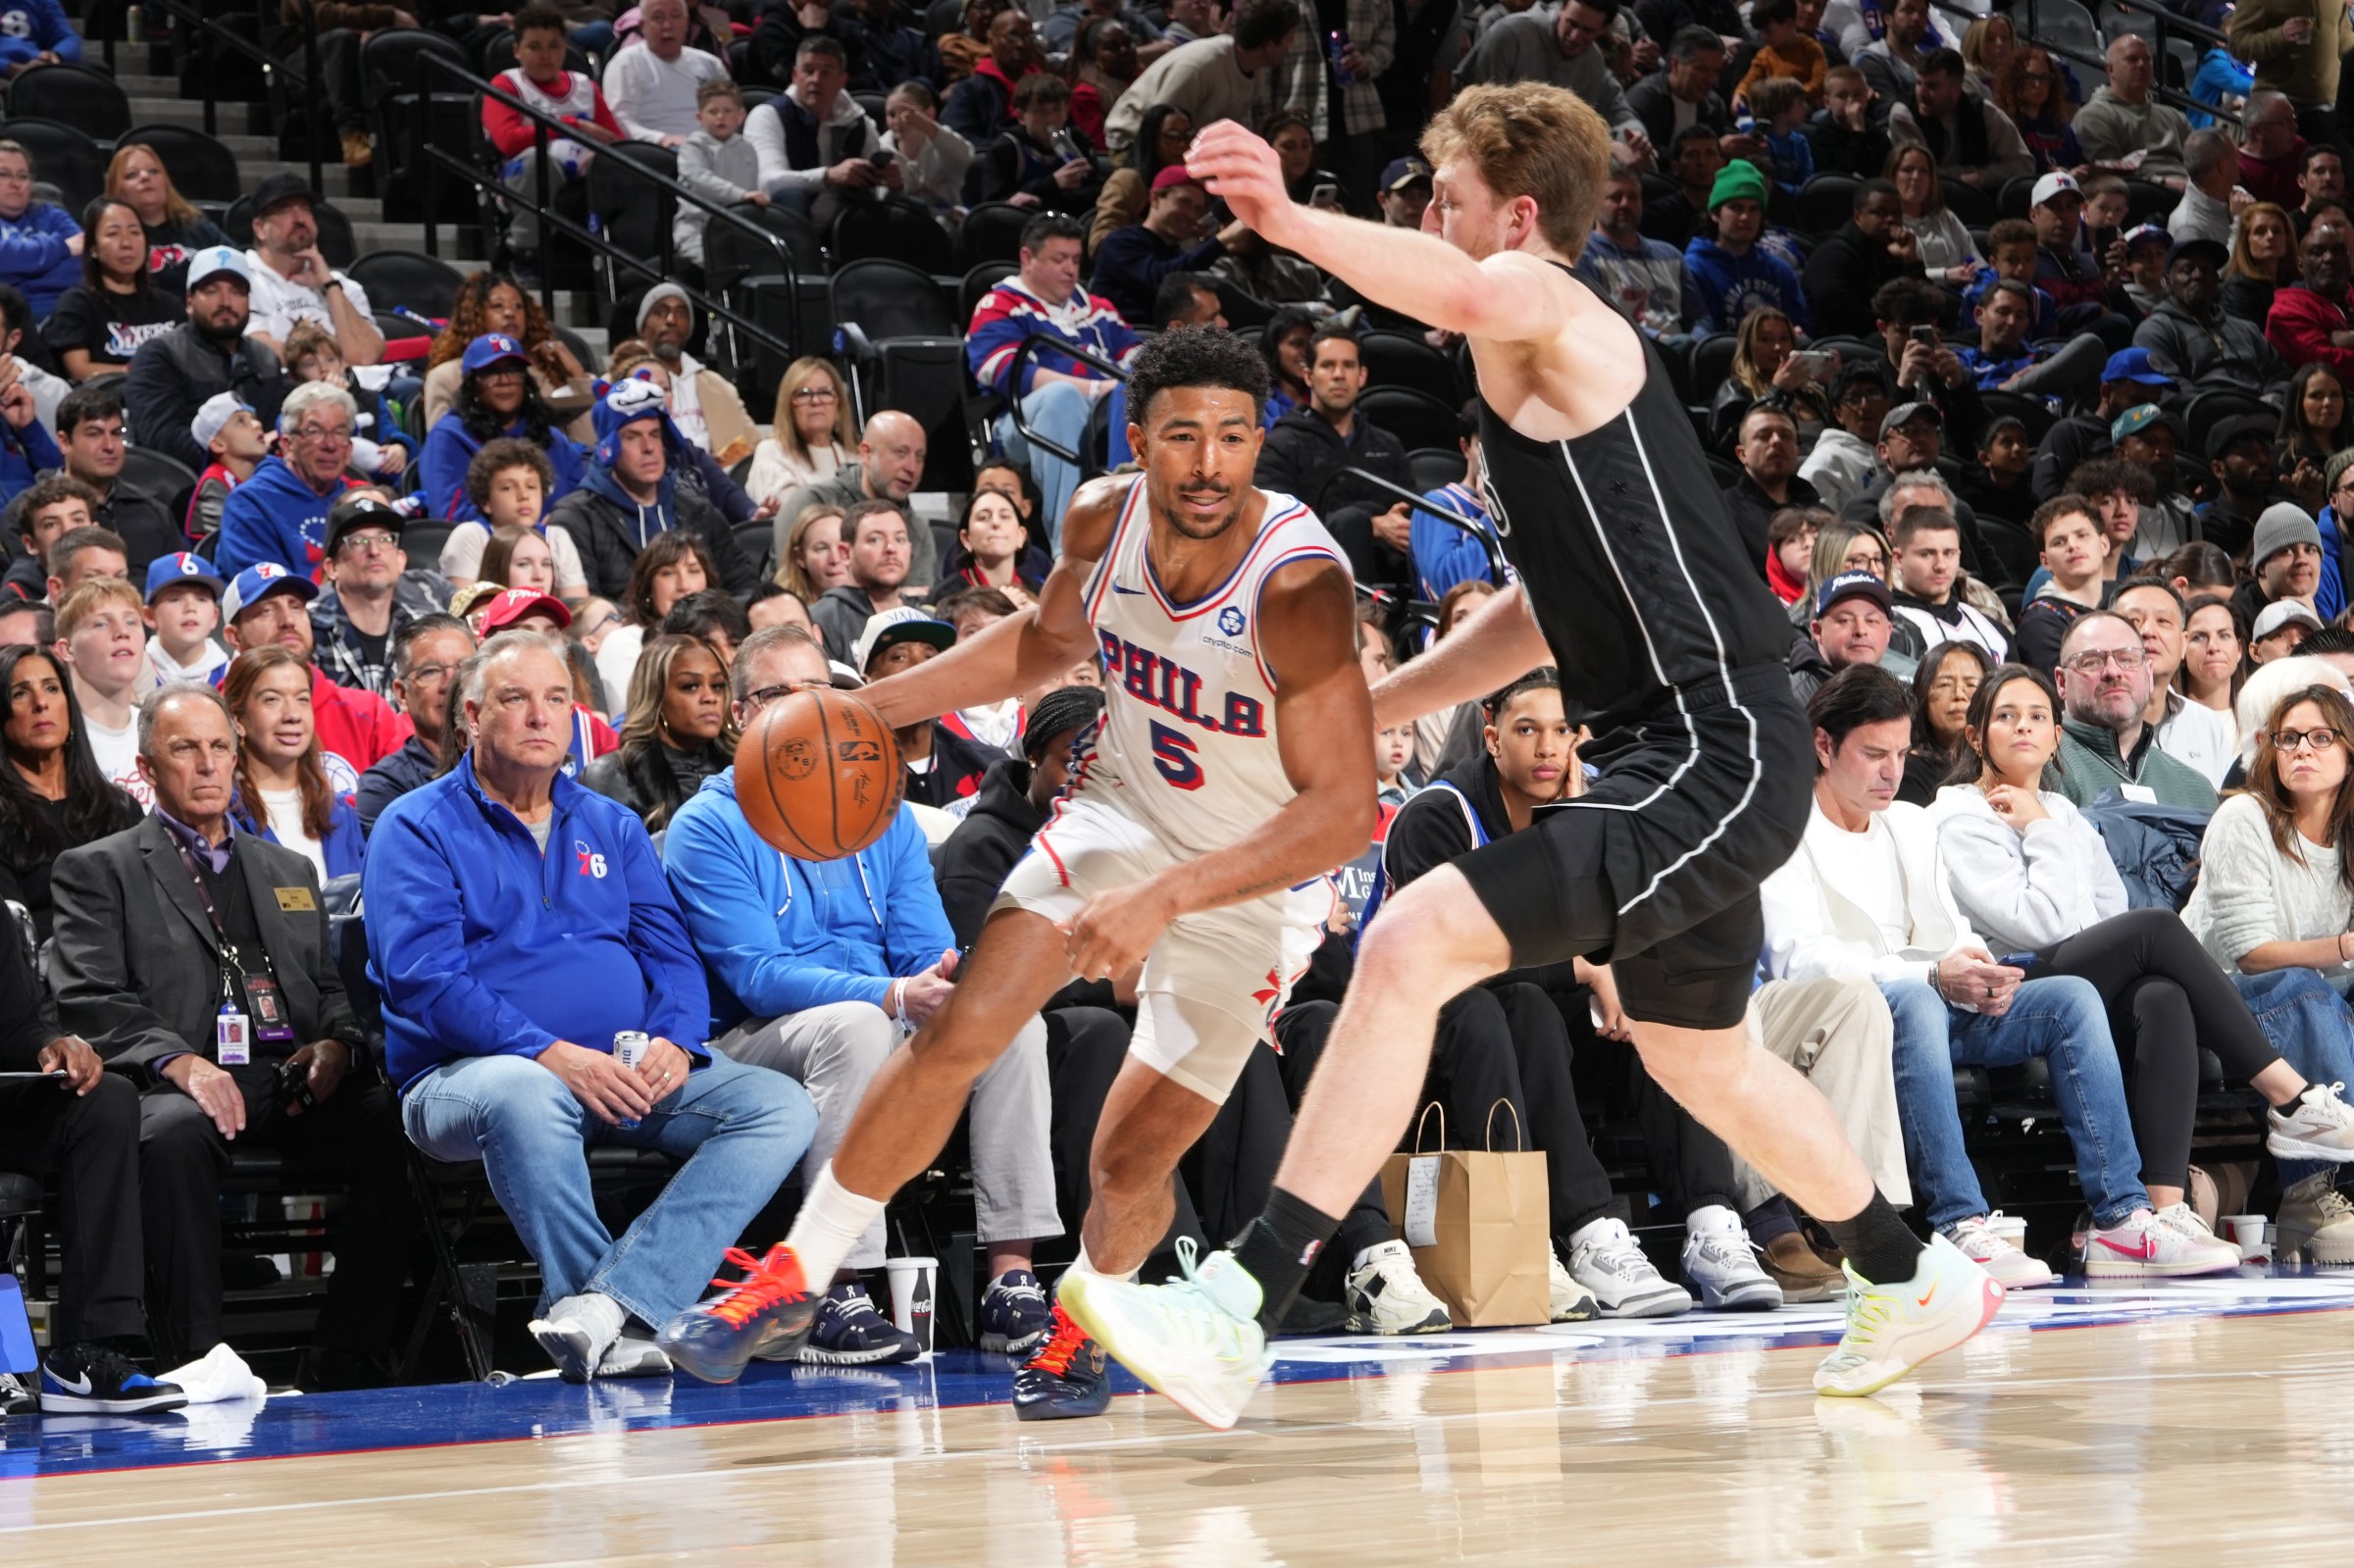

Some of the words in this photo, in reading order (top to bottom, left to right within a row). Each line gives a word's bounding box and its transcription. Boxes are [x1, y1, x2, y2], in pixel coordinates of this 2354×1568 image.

[174, 551, 199, 576] 76
[1203, 635, 1254, 659] crypto.com
[1099, 628, 1267, 737] PHILA
[1149, 718, 1205, 791] 5
[577, 851, 608, 879] 76
[1357, 869, 1377, 884] Ins
[1383, 1245, 1397, 1254] NIKE
